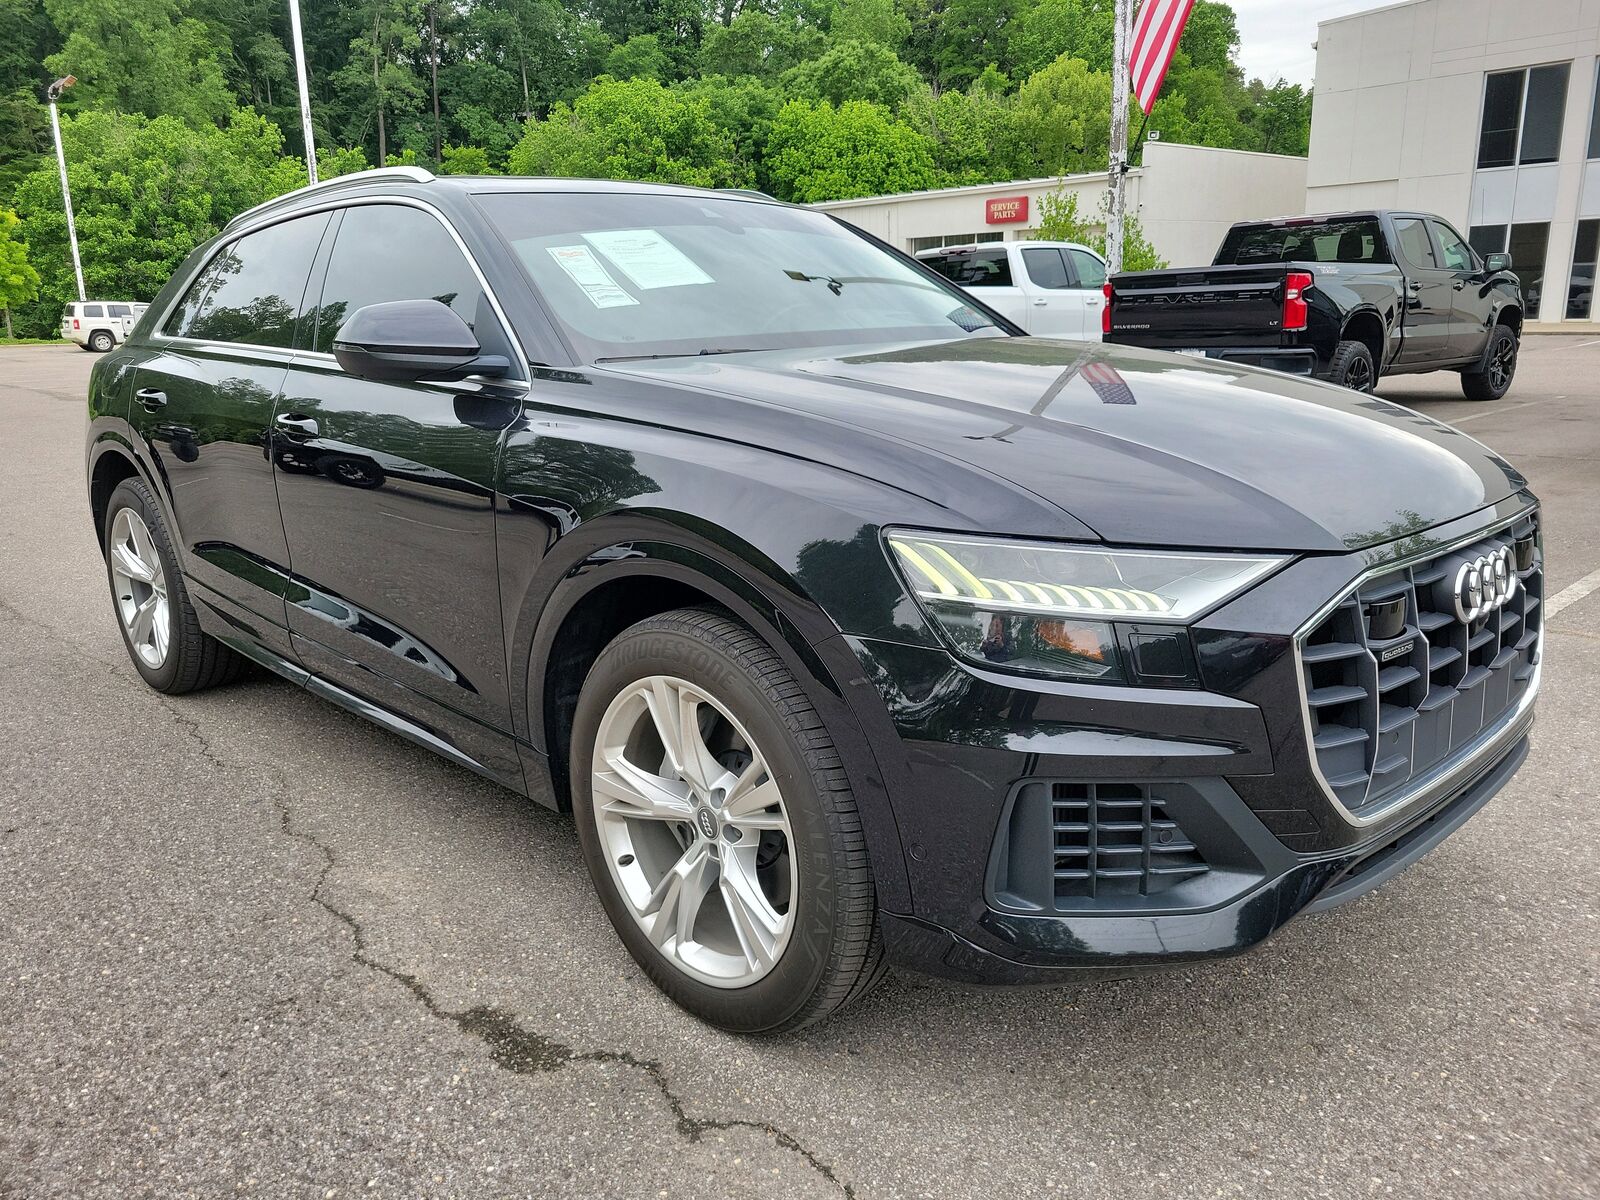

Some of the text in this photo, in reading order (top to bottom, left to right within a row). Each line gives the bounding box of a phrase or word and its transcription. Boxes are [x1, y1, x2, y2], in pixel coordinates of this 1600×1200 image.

[991, 202, 1020, 211] SERVICE
[994, 210, 1016, 219] PARTS
[1384, 643, 1413, 660] quattro
[610, 637, 737, 692] BRIDGESTONE
[802, 808, 832, 935] ALENZA
